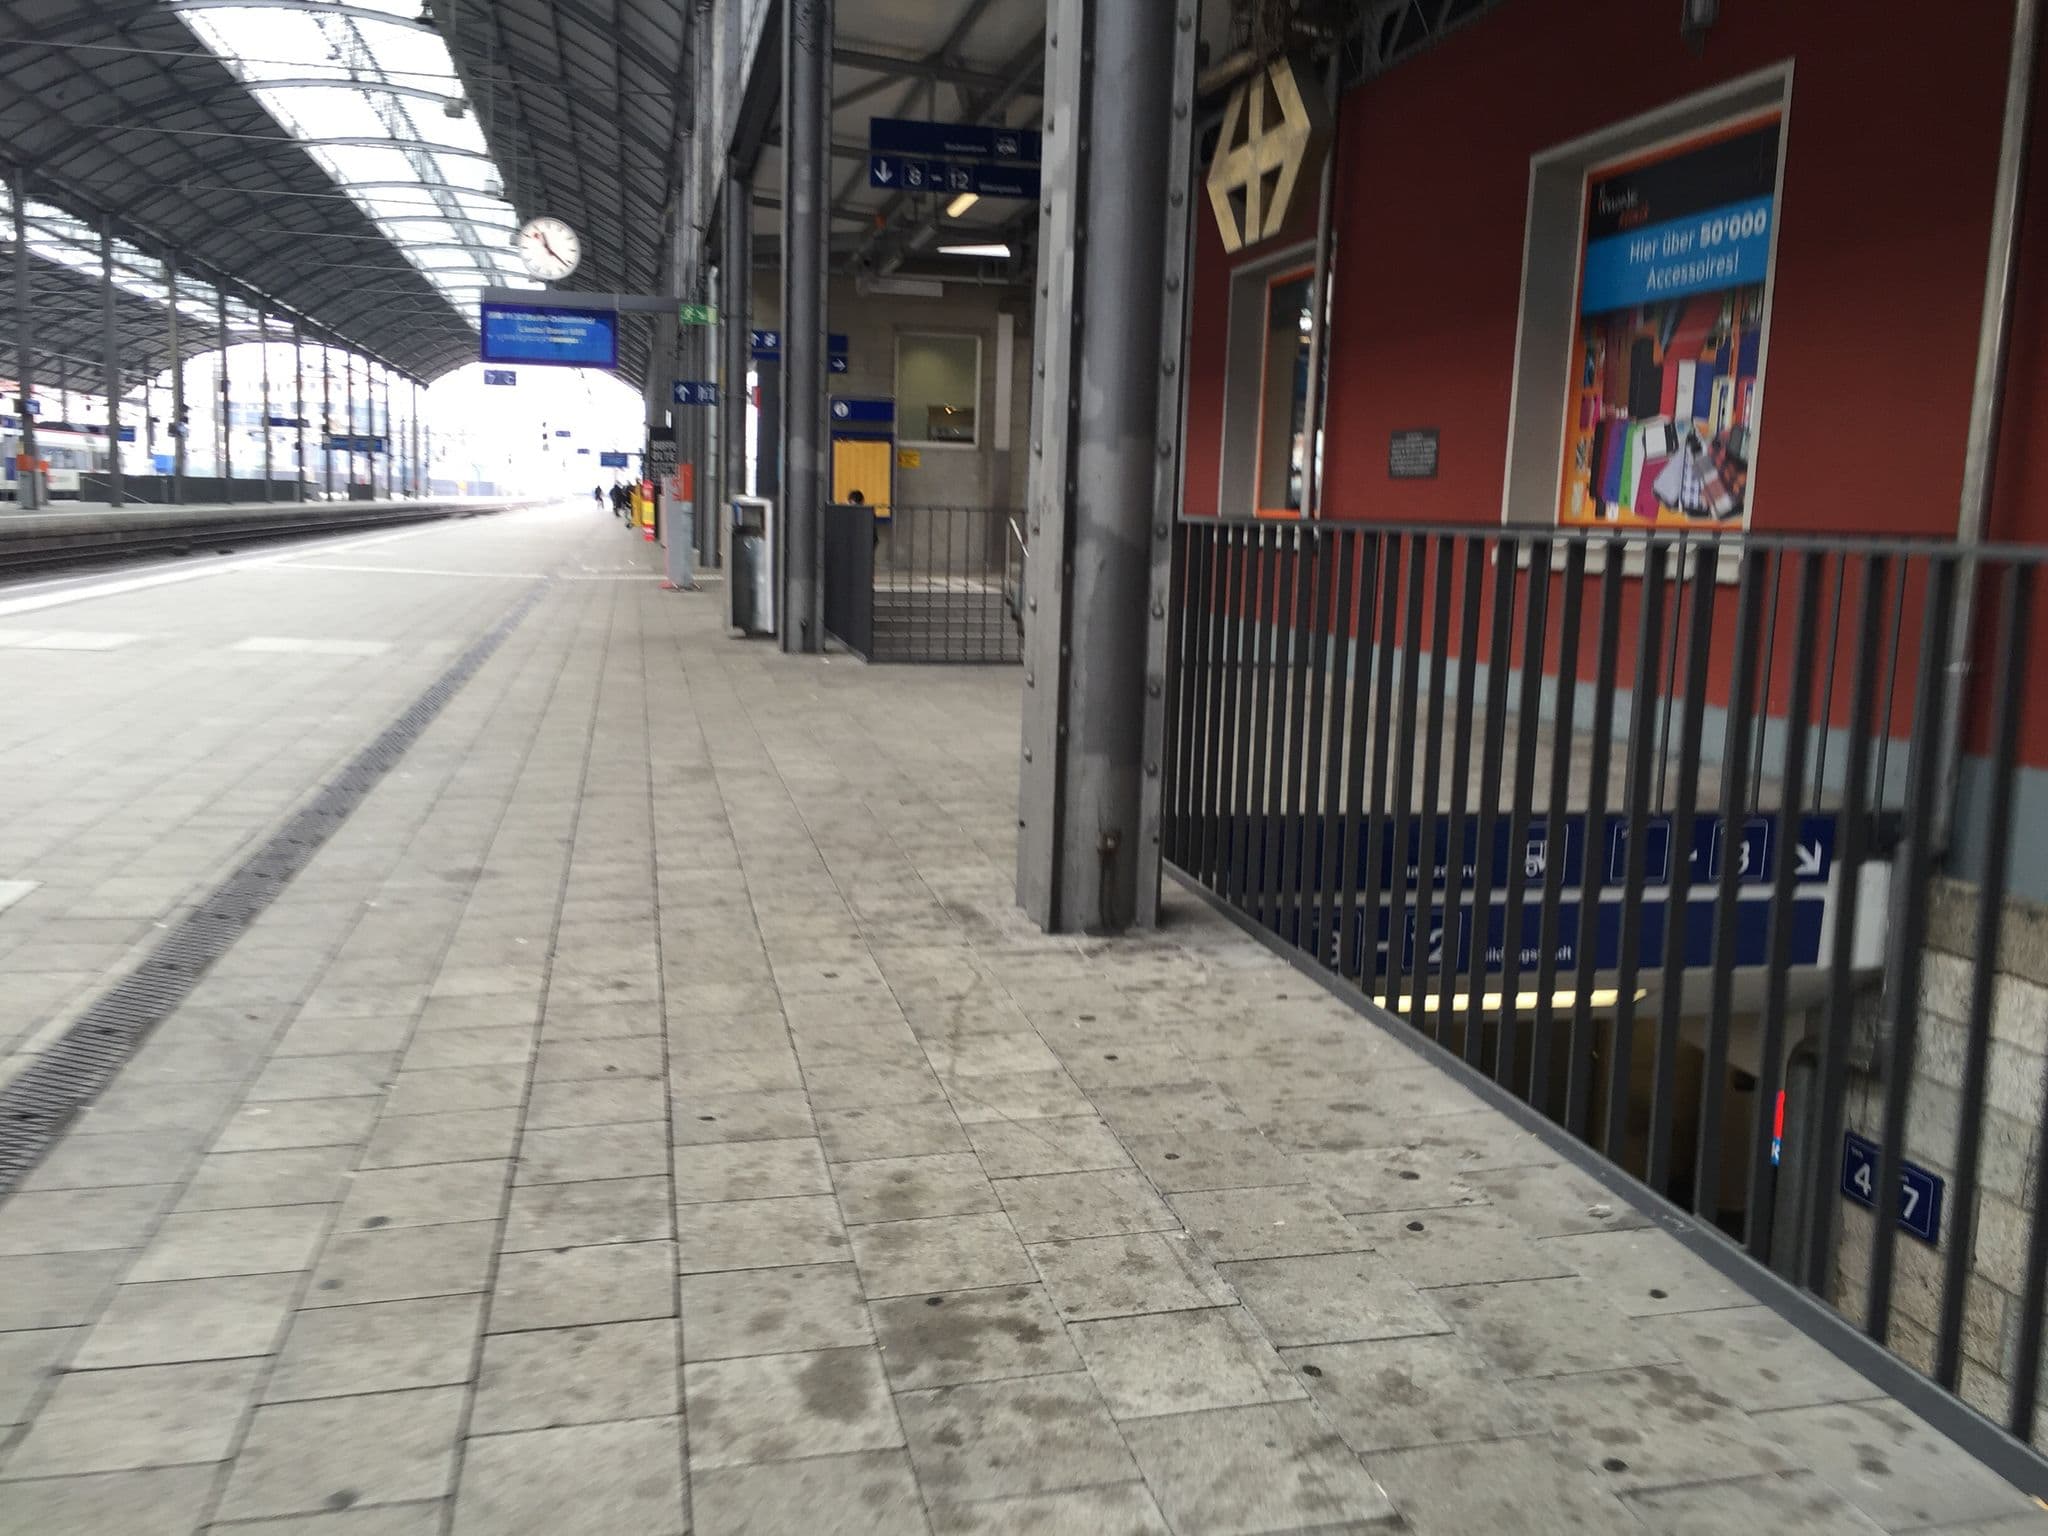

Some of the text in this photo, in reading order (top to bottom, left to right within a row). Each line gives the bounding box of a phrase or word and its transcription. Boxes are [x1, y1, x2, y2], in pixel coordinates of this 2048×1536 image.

[1629, 207, 1767, 265] Hier über 50'000
[1646, 244, 1739, 293] Accessoires!
